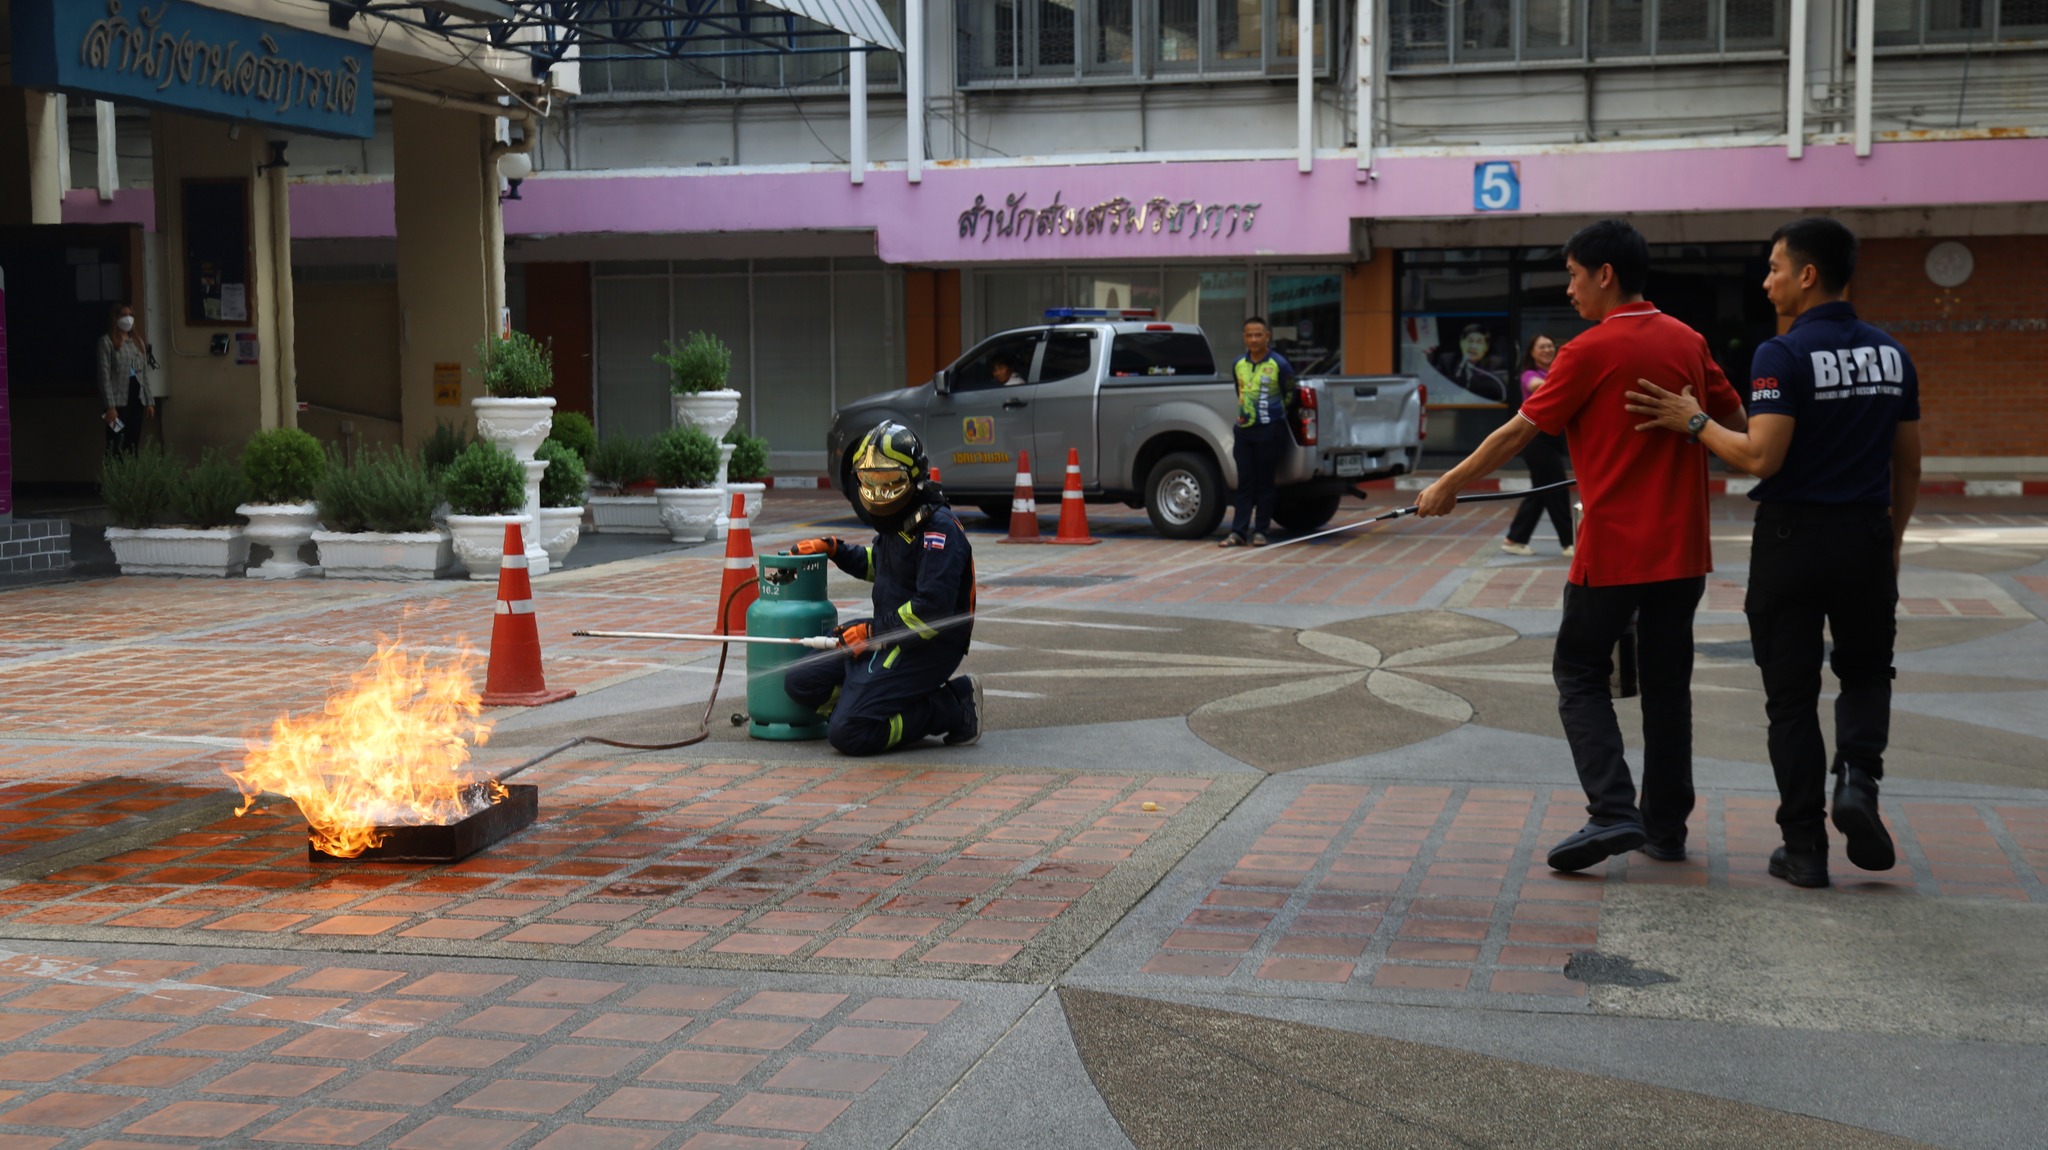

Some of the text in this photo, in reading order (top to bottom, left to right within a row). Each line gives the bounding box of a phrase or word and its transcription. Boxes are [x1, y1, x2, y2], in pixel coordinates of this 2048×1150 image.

[81, 0, 361, 114] สำนักงานอธิการบดี
[1481, 164, 1512, 209] 5
[957, 190, 1262, 242] สำนักส่งเสริมวิชาการ
[1752, 377, 1778, 390] 199
[1810, 345, 1904, 388] BFRD
[1751, 389, 1781, 402] BFRD
[761, 585, 780, 596] 16.2
